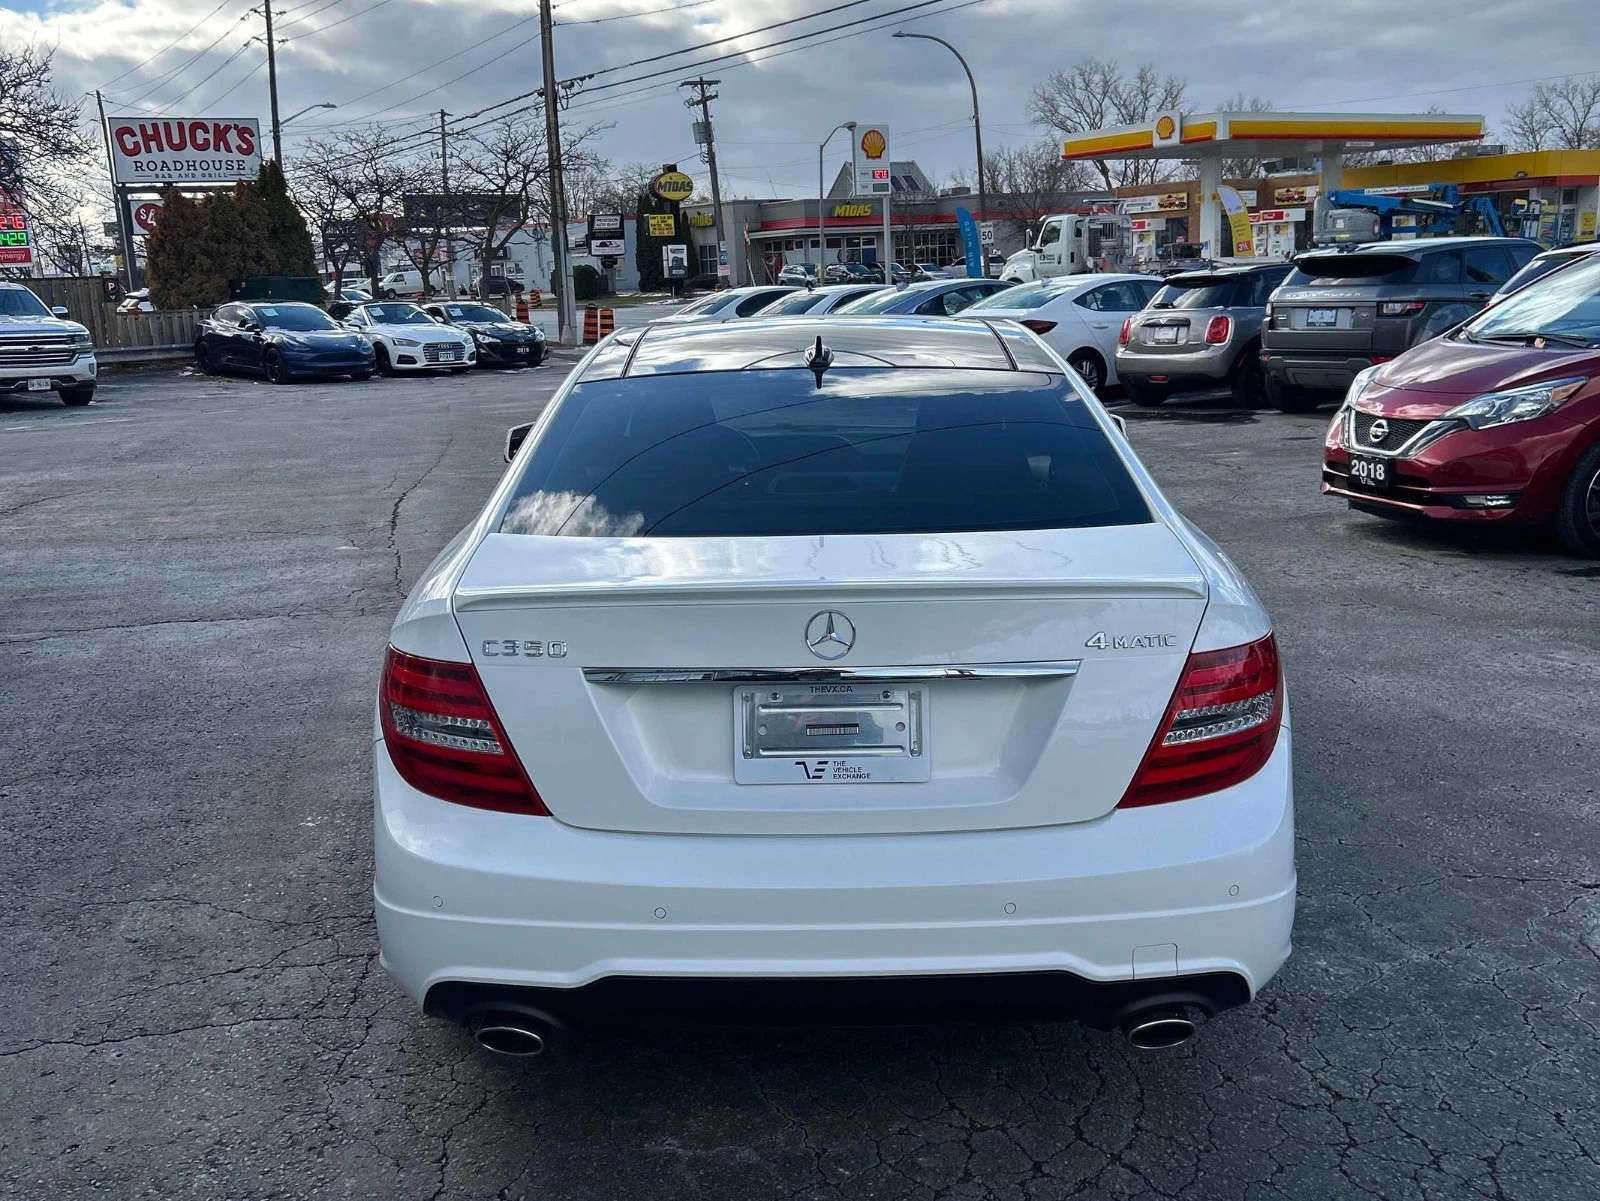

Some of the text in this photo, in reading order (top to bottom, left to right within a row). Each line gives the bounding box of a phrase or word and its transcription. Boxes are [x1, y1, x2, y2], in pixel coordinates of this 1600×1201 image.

[115, 121, 256, 157] CHUCK'S
[134, 159, 246, 172] ROADHOUSE
[657, 180, 693, 193] MIDAS
[834, 204, 873, 218] MIDAS
[964, 220, 973, 247] MILES
[982, 230, 993, 241] 50
[108, 282, 115, 291] P
[1351, 459, 1385, 480] 2018
[482, 639, 568, 659] C350
[809, 685, 853, 693] THEVX.CA
